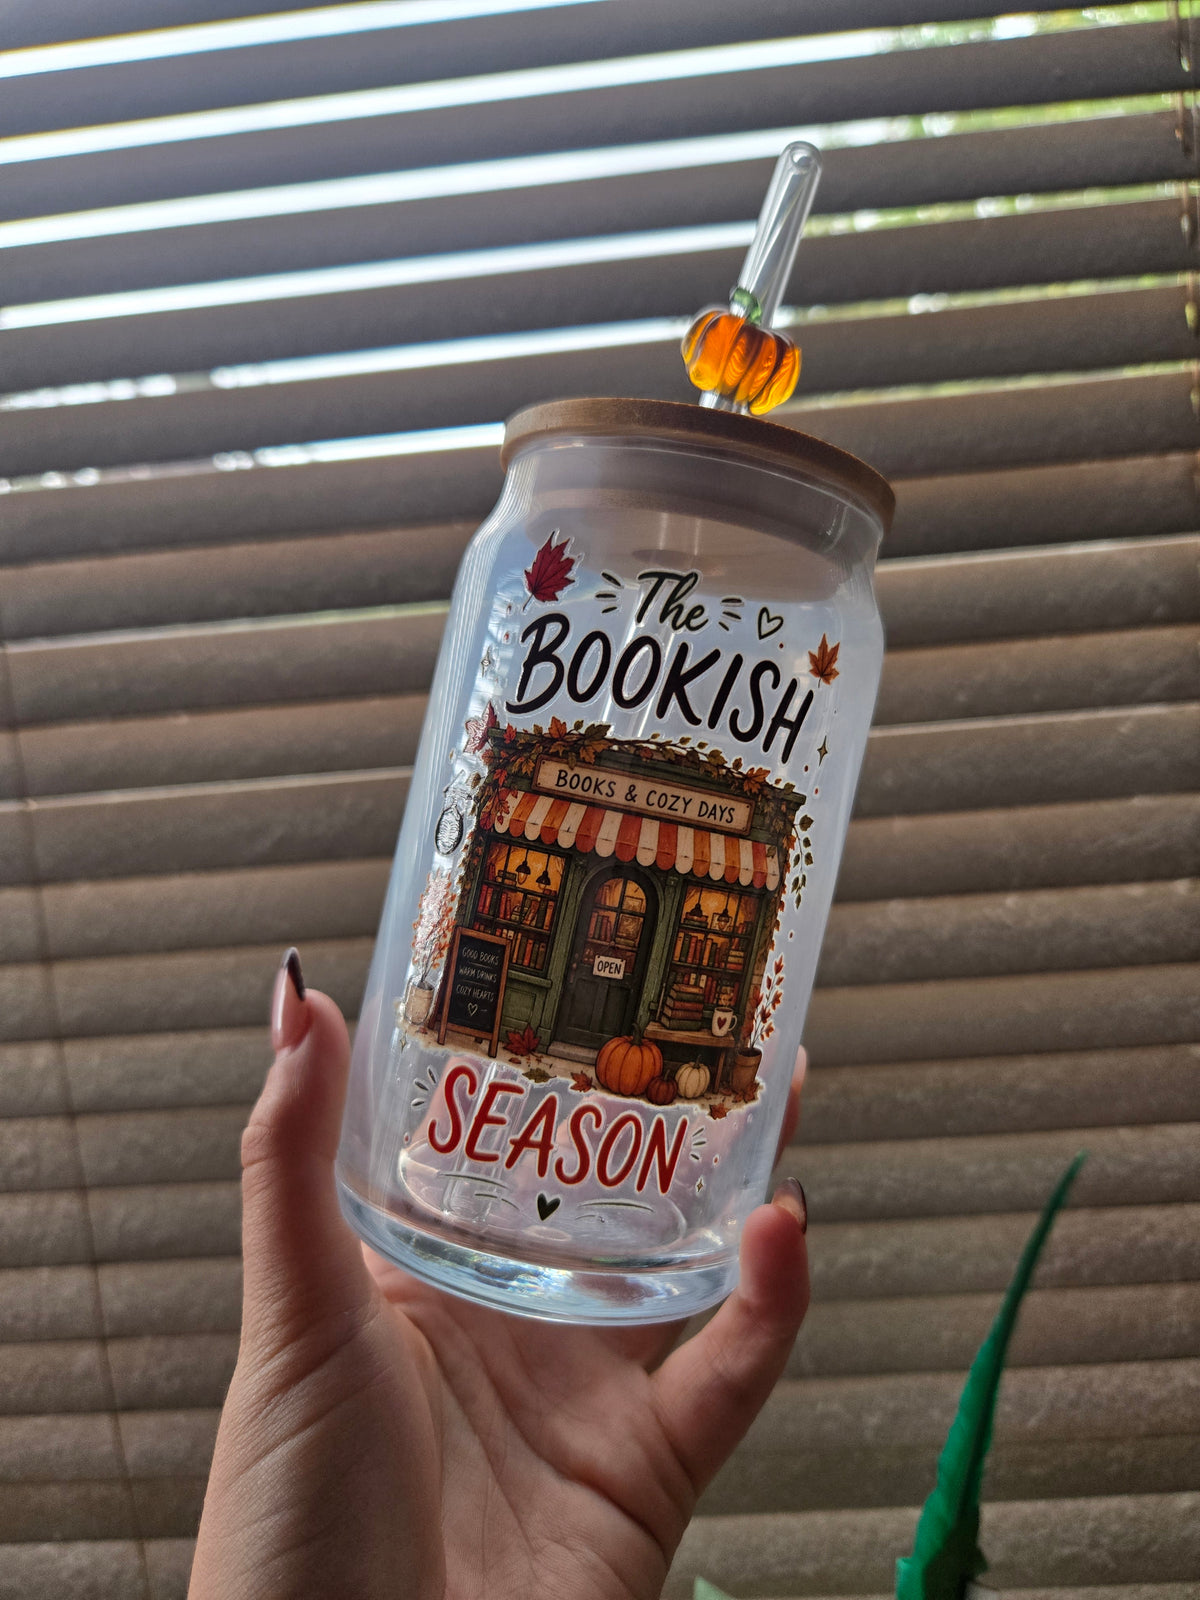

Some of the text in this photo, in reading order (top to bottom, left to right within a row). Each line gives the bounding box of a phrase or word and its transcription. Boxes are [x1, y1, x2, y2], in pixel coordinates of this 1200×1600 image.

[638, 571, 709, 631] The
[505, 612, 814, 764] BOOKISH
[556, 769, 736, 824] BOOKS & COZY DAYS
[462, 946, 499, 966] GOOD BOOKS
[597, 960, 622, 975] OPEN
[456, 984, 494, 1002] COZY HEARTS
[458, 967, 497, 983] WARM DRINKS
[428, 1065, 688, 1194] SEASON
